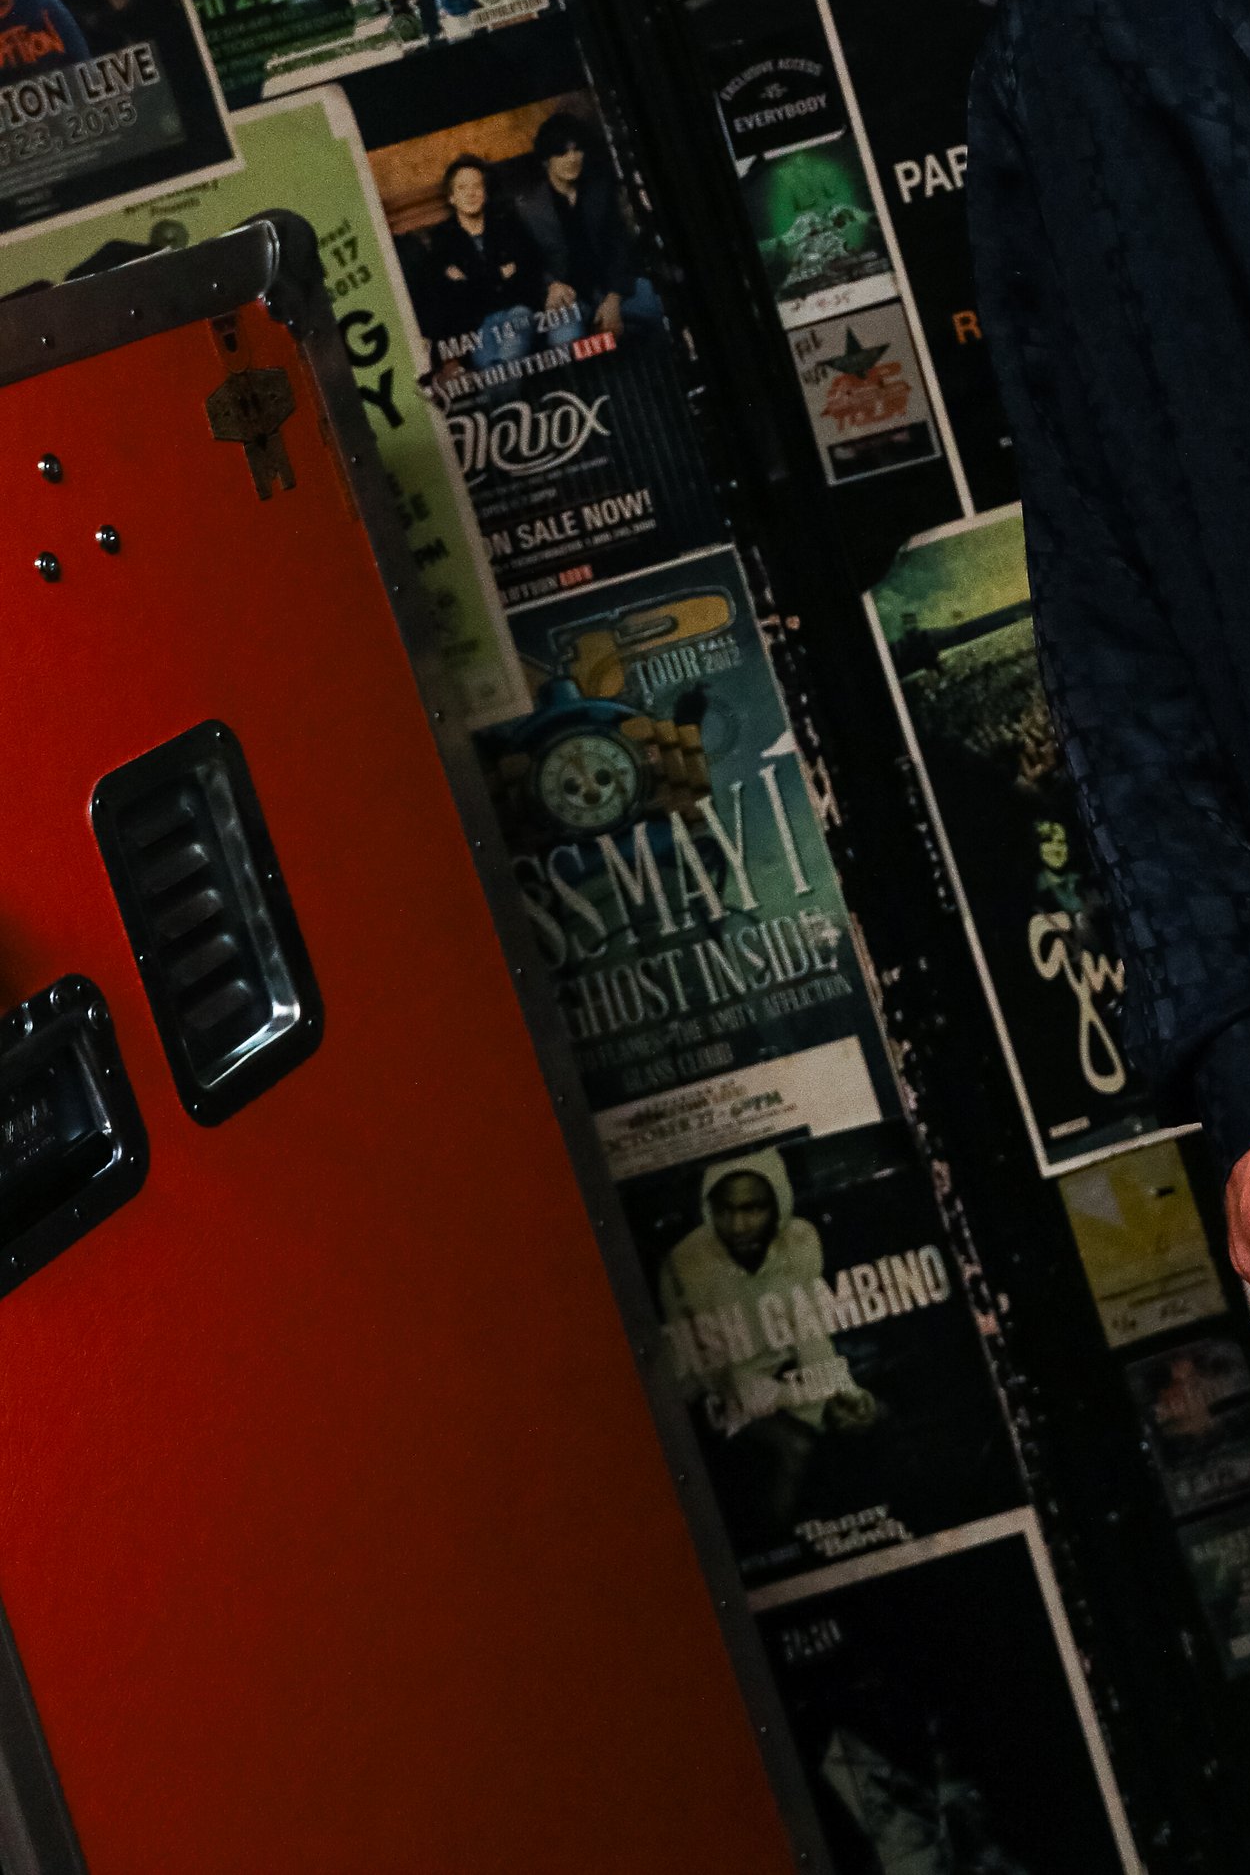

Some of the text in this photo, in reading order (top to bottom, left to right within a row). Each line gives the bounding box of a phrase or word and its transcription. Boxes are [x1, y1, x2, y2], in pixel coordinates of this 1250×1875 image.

[75, 39, 160, 103] LIVE
[732, 92, 829, 134] EVERYBODY
[436, 328, 487, 362] MAY
[534, 301, 583, 335] 2011
[447, 330, 617, 398] REVOLUTION LIVE
[516, 508, 580, 549] SALE
[581, 487, 655, 530] NOW!
[633, 649, 701, 707] TOUR
[512, 763, 811, 972] SS MAY I
[558, 903, 841, 1042] GHOST INSIDE
[755, 1243, 952, 1351] GAMBINO
